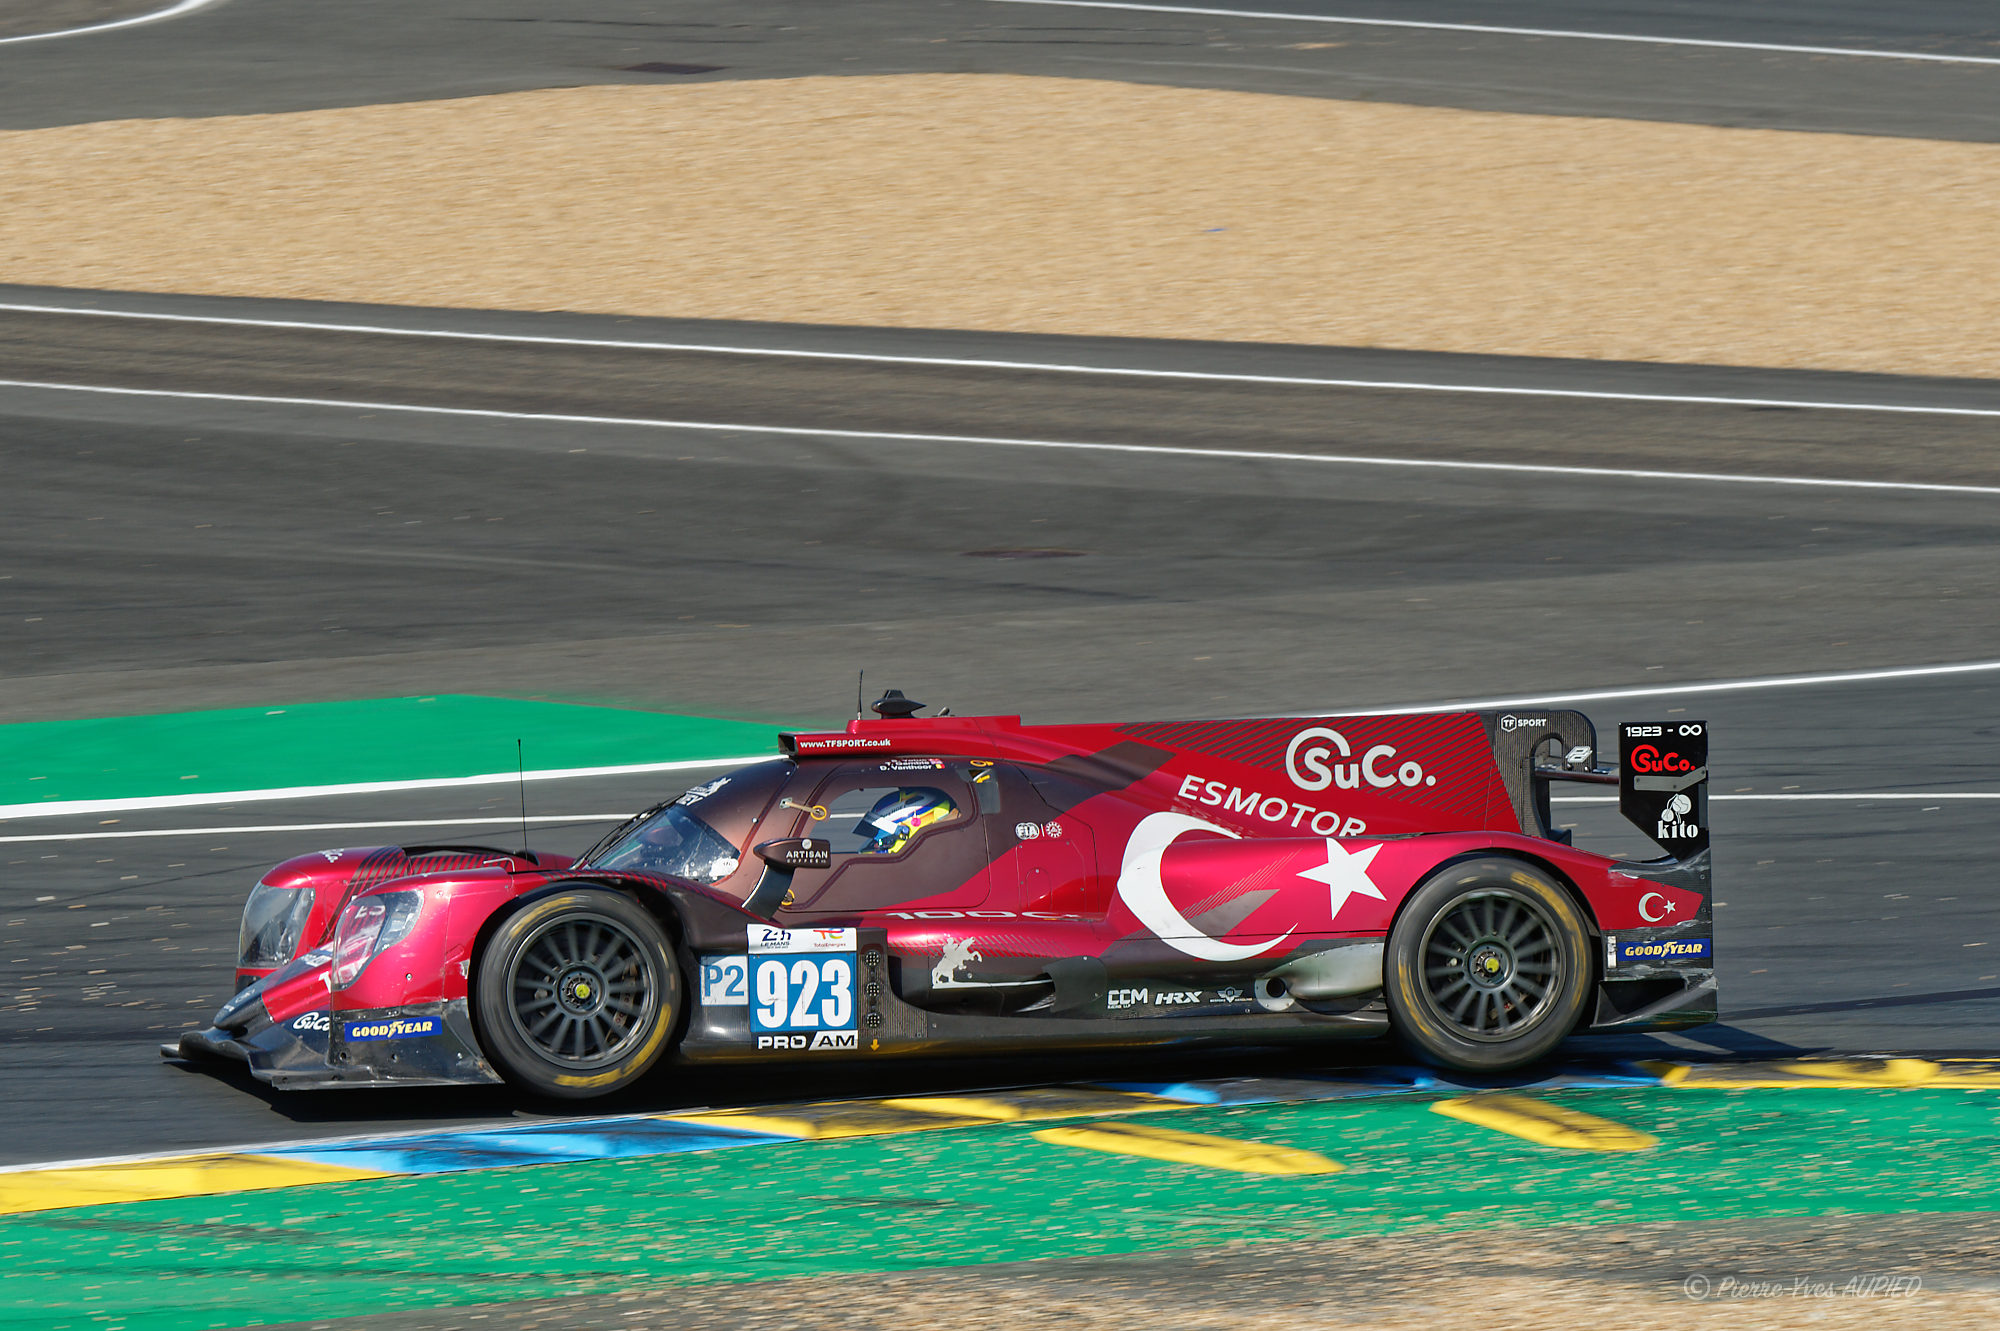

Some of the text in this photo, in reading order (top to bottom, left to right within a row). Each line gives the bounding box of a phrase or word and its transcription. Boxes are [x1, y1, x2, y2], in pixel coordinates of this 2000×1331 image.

[1518, 718, 1547, 727] SPORT
[1625, 726, 1662, 737] 1923
[800, 738, 891, 748] www.TFSPORT.co.uk
[1285, 727, 1436, 791] SuCo.
[1631, 744, 1696, 773] SuCo.
[1177, 774, 1366, 837] ESMOTOR
[1016, 823, 1039, 838] FIA
[1657, 820, 1699, 839] kito
[786, 850, 828, 858] ARTISAN
[1625, 941, 1703, 958] GOODYEAR
[704, 965, 745, 997] P2
[757, 959, 852, 1028] 923
[1107, 988, 1203, 1005] CCM HRX
[352, 1020, 433, 1038] GOODYEAR
[758, 1035, 855, 1050] PRO AM
